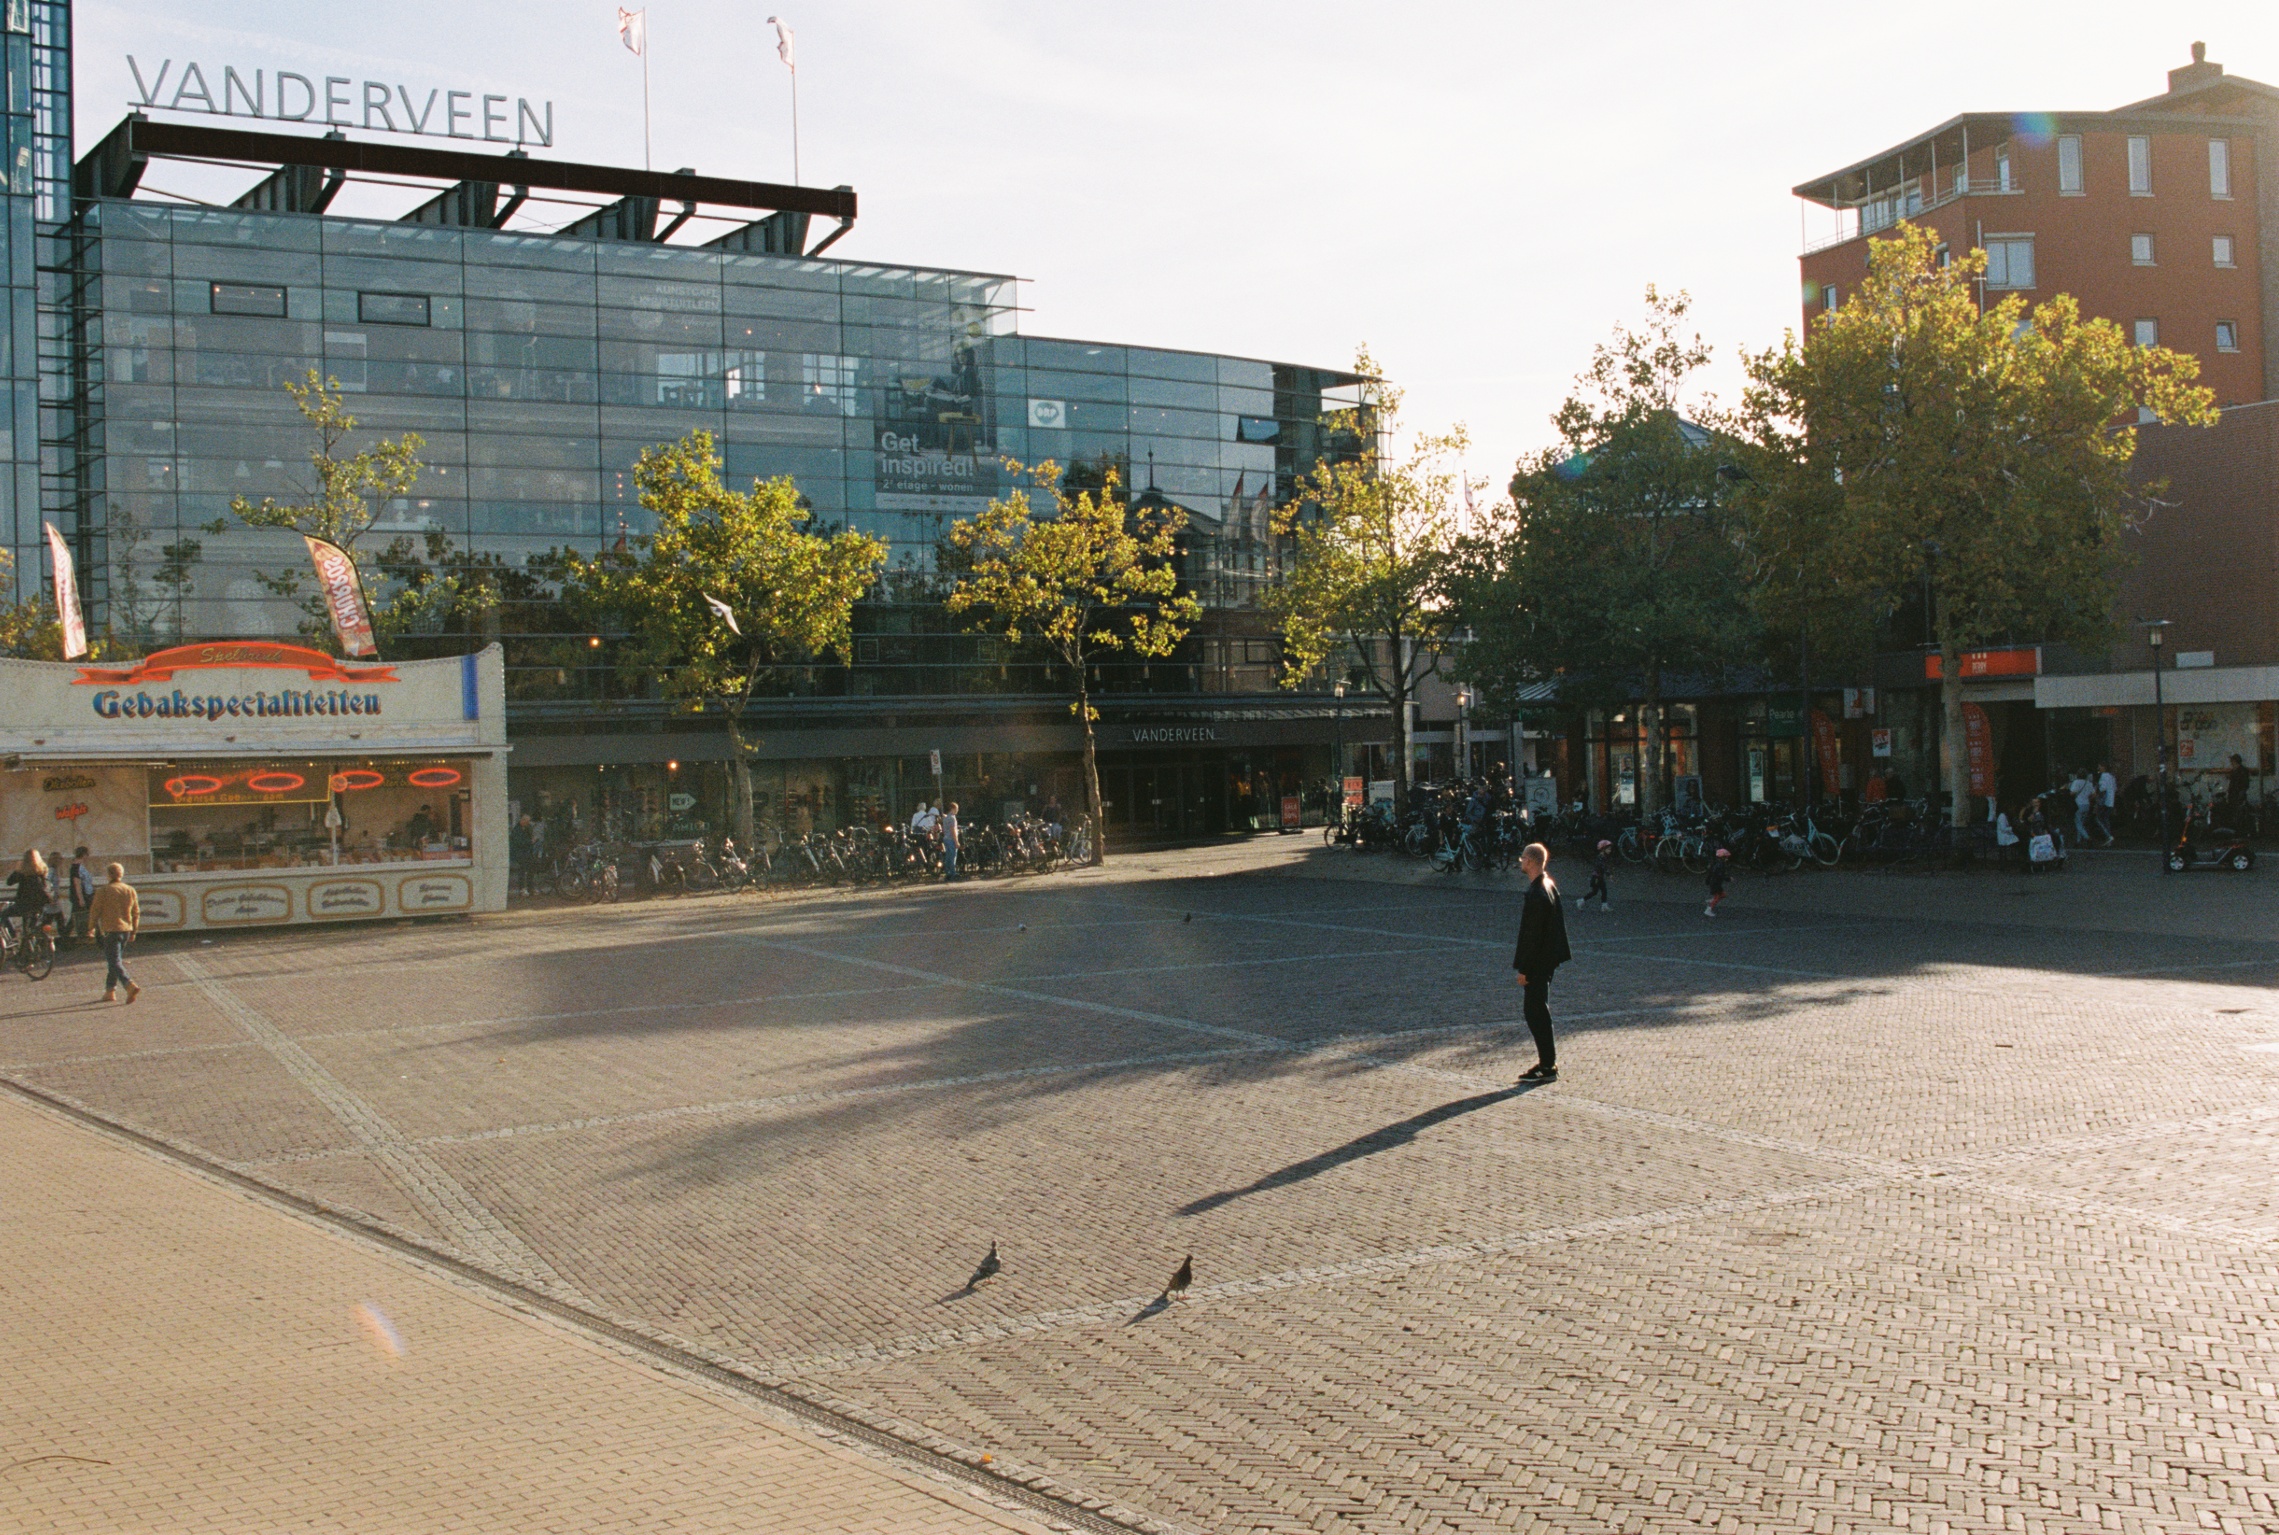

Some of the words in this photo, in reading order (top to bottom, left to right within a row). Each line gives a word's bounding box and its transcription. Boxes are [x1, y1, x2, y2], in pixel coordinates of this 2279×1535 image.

[127, 54, 552, 147] VANDERVEEN
[880, 431, 919, 453] Get
[881, 457, 974, 479] inspired!
[896, 480, 928, 491] etage
[938, 483, 974, 492] wonen
[91, 687, 383, 722] Gebakspecialiteiten
[1132, 727, 1215, 742] VANDERVEEN
